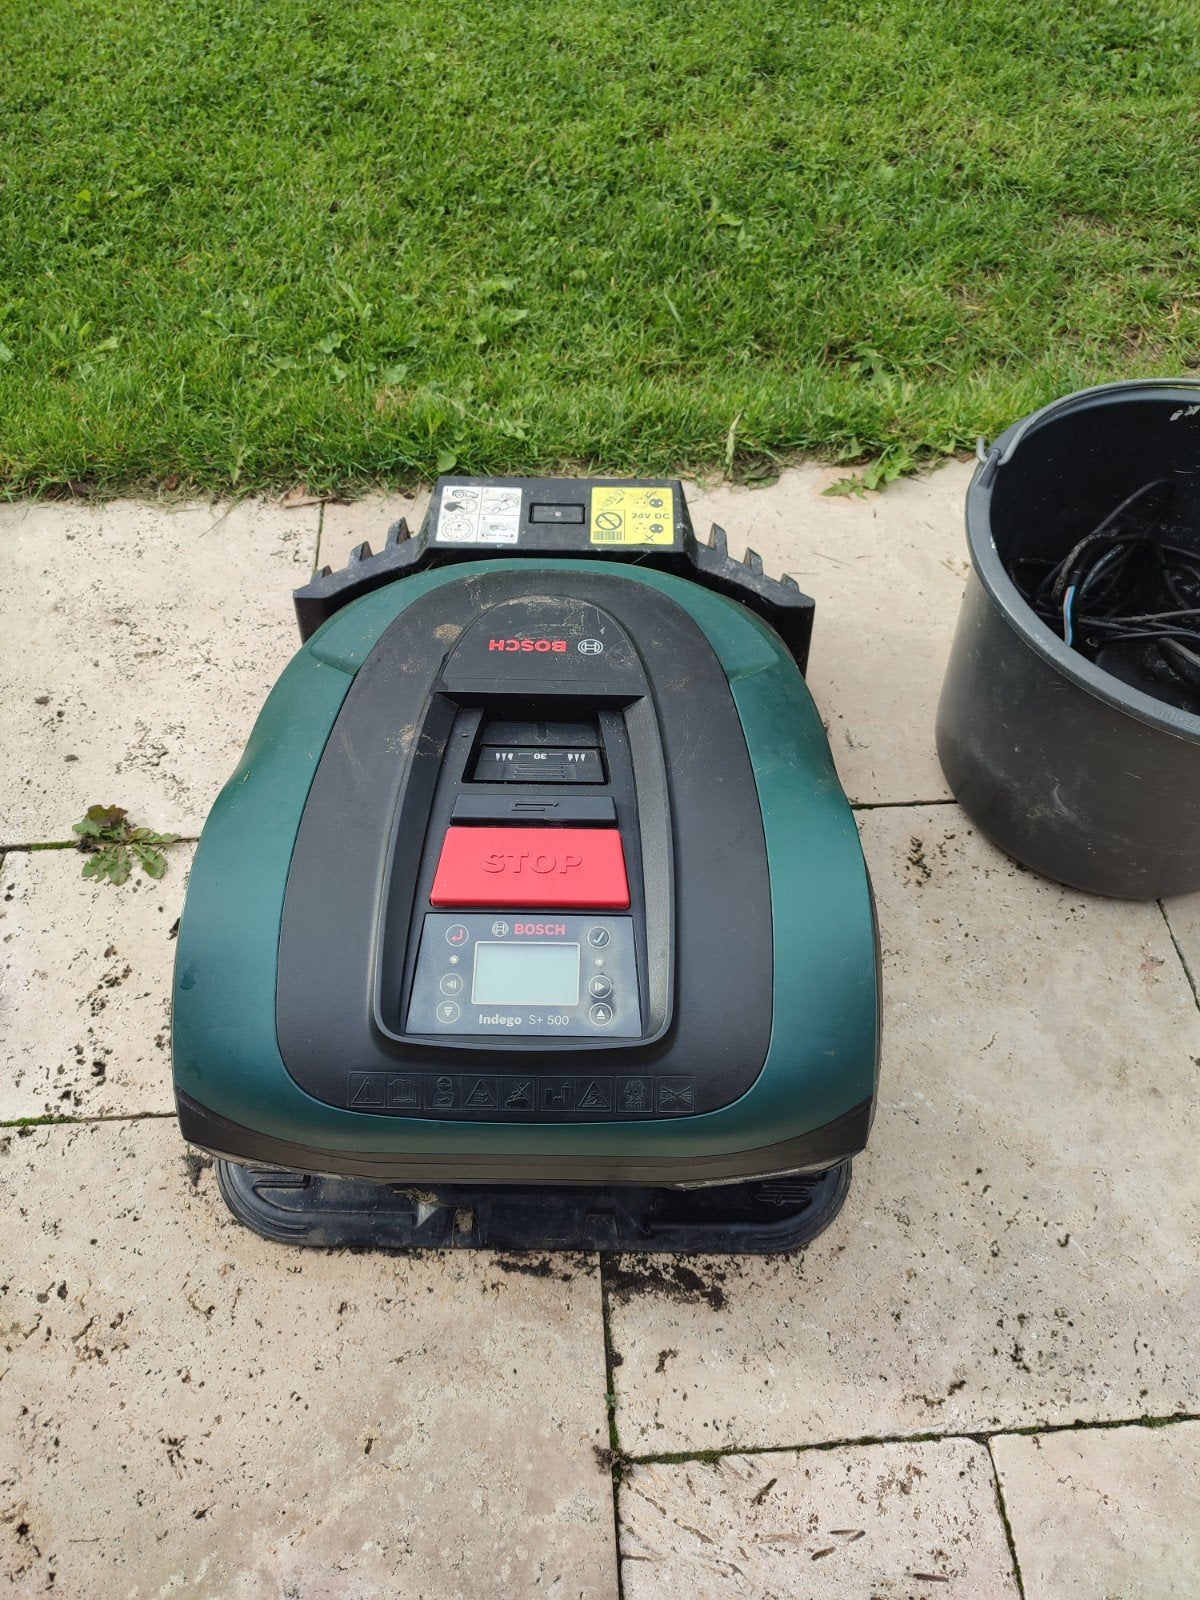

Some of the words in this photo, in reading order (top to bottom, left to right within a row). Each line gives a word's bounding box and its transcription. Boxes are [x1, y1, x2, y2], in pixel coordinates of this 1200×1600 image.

[489, 639, 567, 652] BOSCH
[481, 850, 583, 874] STOP
[514, 923, 566, 936] BOSCH
[478, 1013, 523, 1027] Indego
[528, 1014, 544, 1026] S+
[547, 1015, 570, 1026] 500
